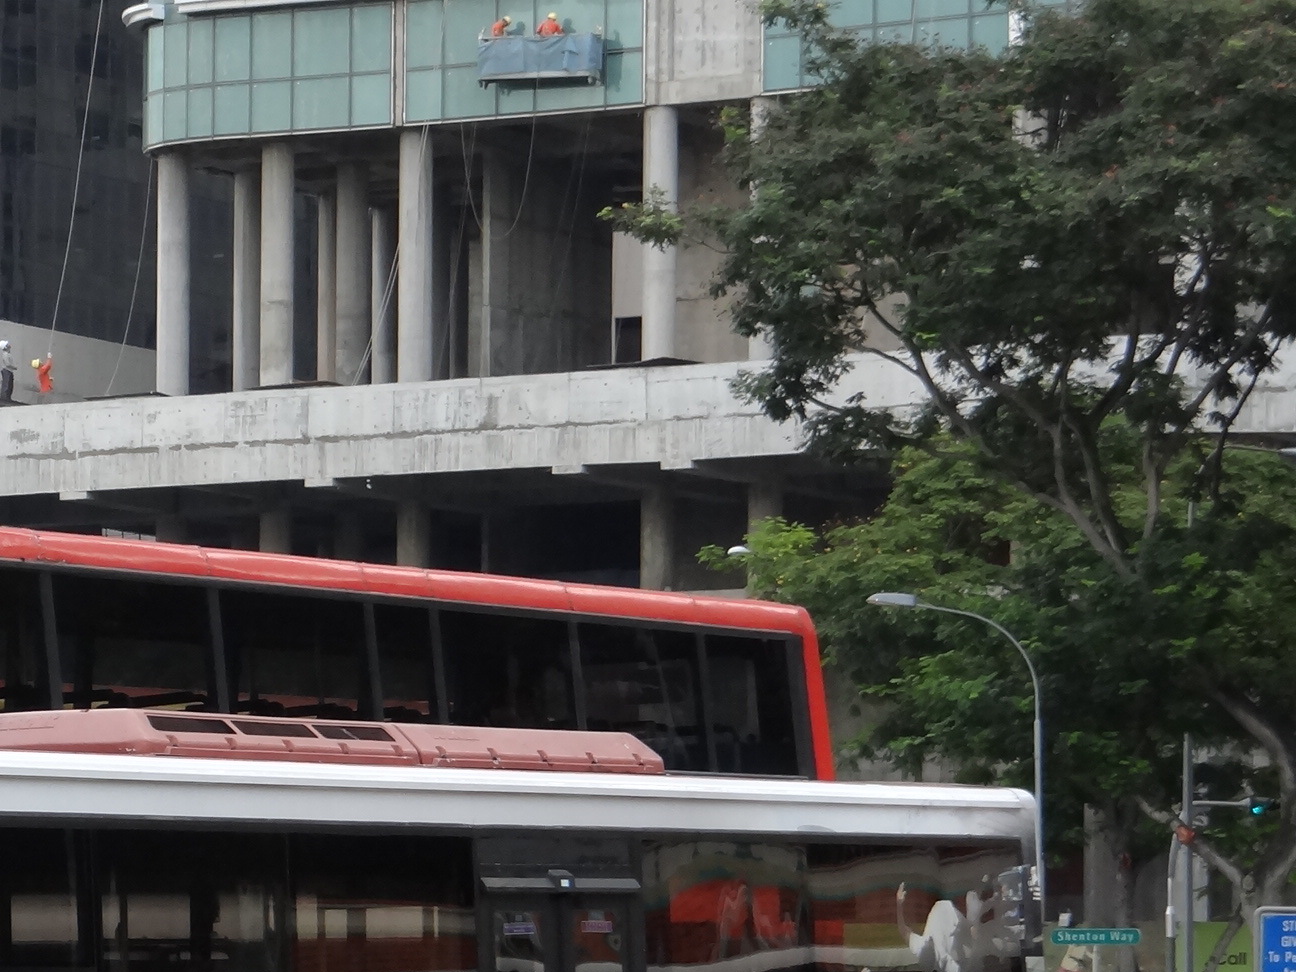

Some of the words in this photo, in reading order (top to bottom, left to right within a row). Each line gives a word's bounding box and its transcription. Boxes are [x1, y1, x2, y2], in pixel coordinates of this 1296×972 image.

[1057, 931, 1106, 942] Shenton
[1109, 931, 1134, 943] Way
[1268, 950, 1280, 963] To
